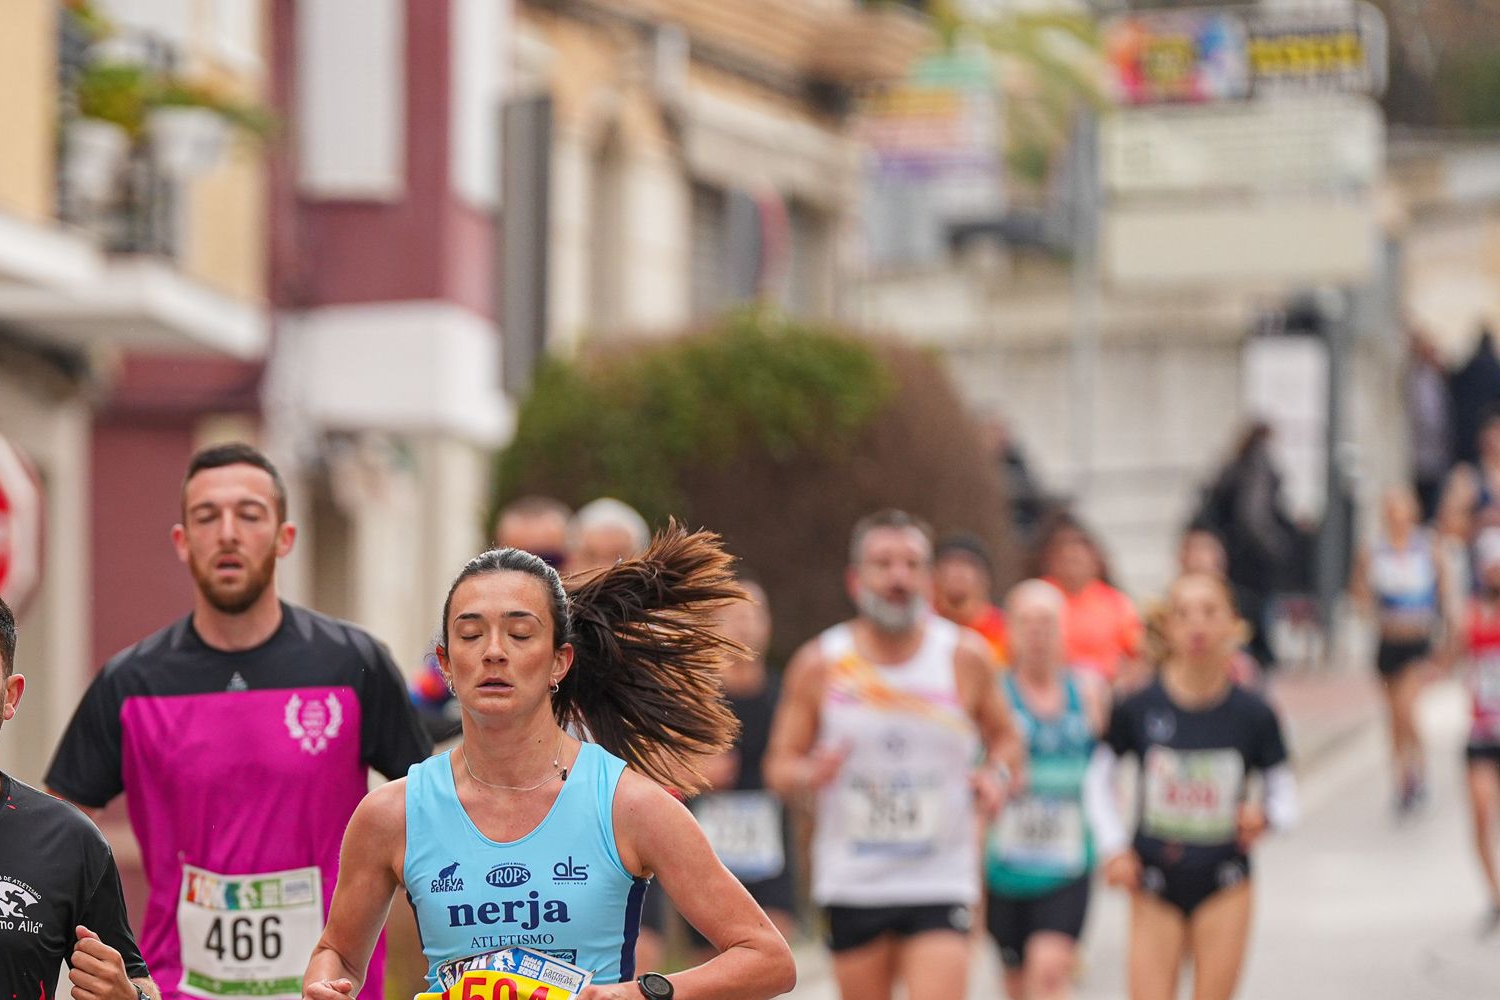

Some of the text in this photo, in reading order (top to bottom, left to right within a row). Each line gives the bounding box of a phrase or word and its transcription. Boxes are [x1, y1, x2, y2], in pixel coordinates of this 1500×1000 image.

[431, 878, 464, 888] CUEVA
[488, 868, 529, 884] TROPS
[12, 878, 41, 900] ATLETISMO
[447, 891, 571, 930] nerja
[204, 915, 282, 961] 466
[470, 933, 554, 948] ATLETISMO
